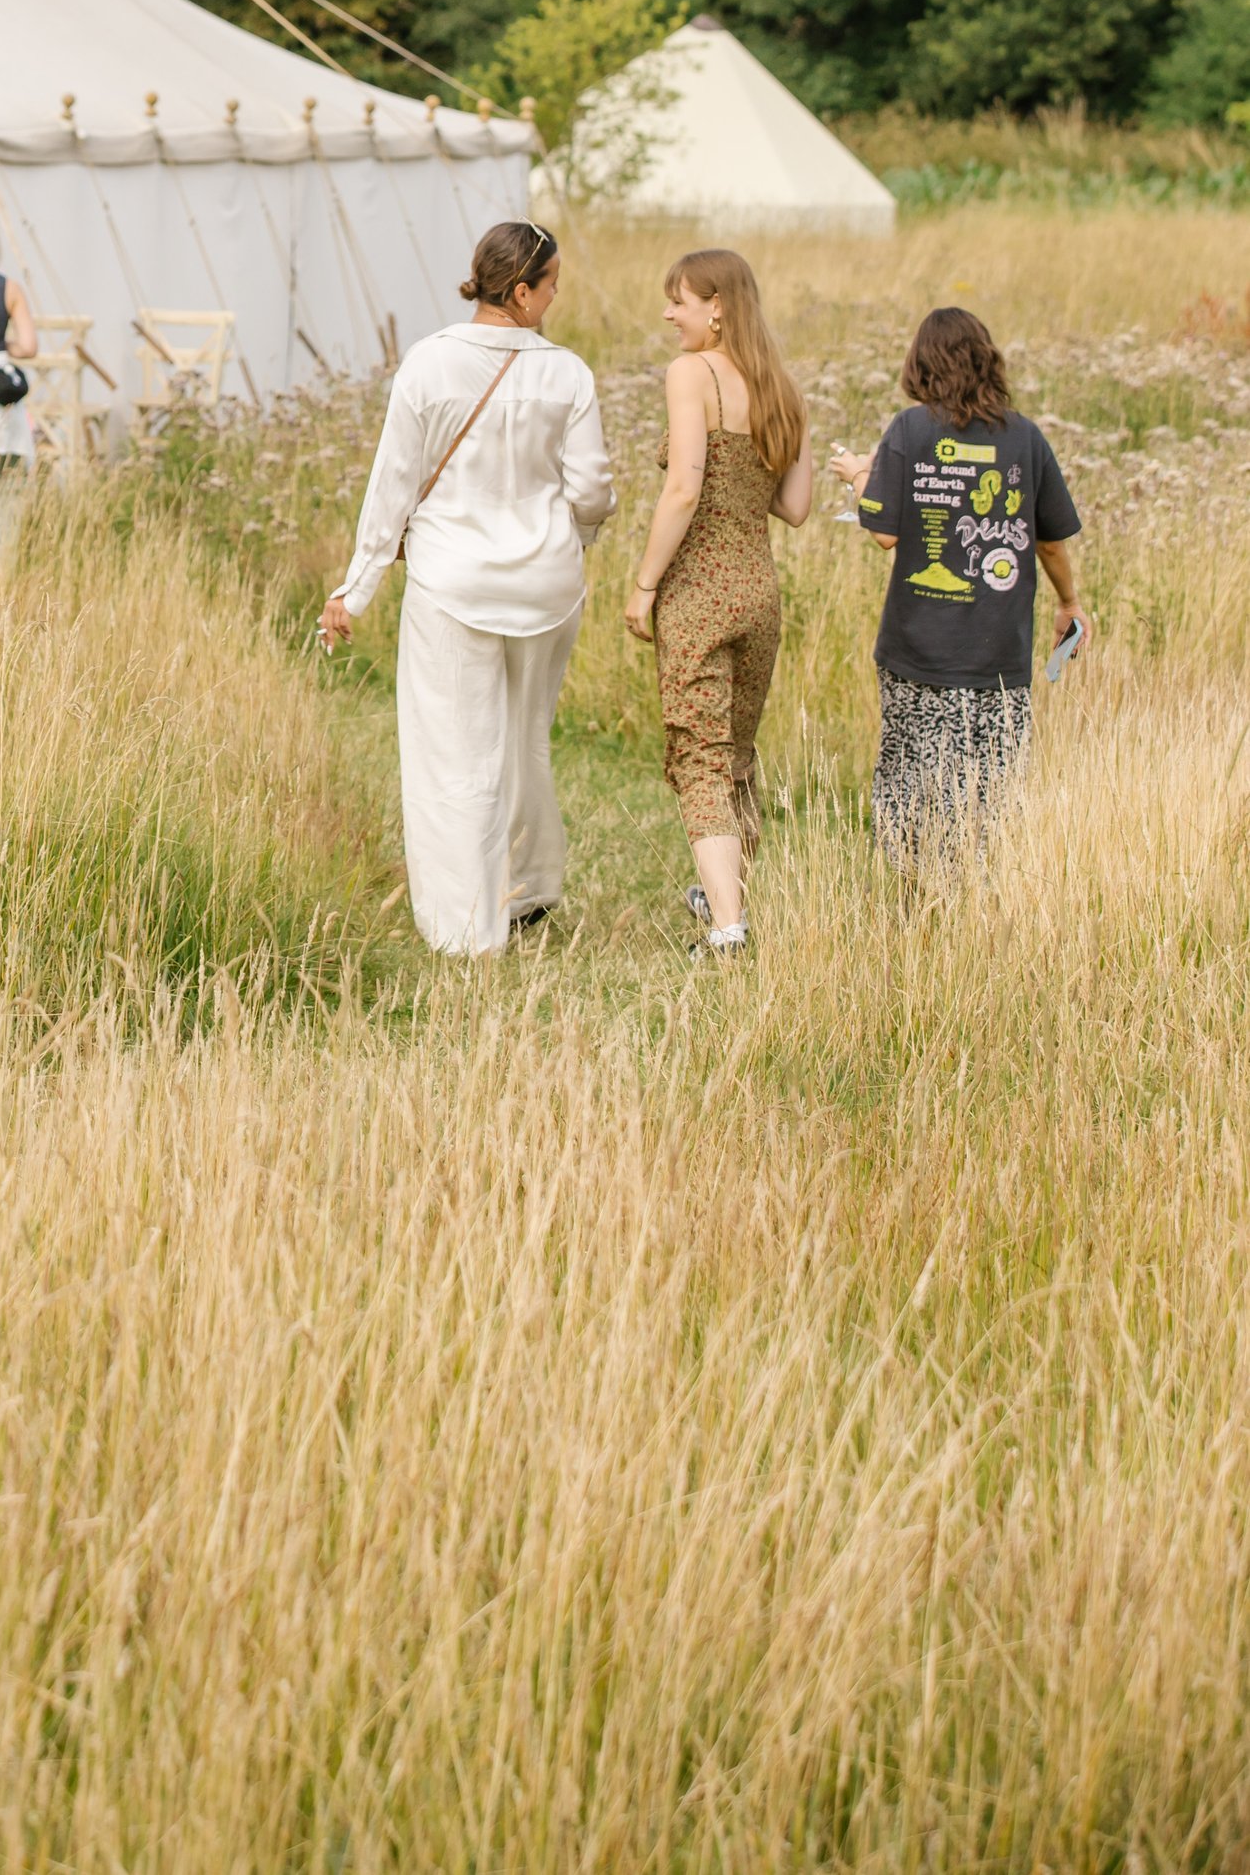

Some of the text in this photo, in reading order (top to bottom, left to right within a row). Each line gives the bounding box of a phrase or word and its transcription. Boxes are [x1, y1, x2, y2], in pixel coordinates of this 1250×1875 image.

[914, 462, 977, 477] the sound
[913, 477, 966, 491] of Earth
[912, 491, 962, 508] turning
